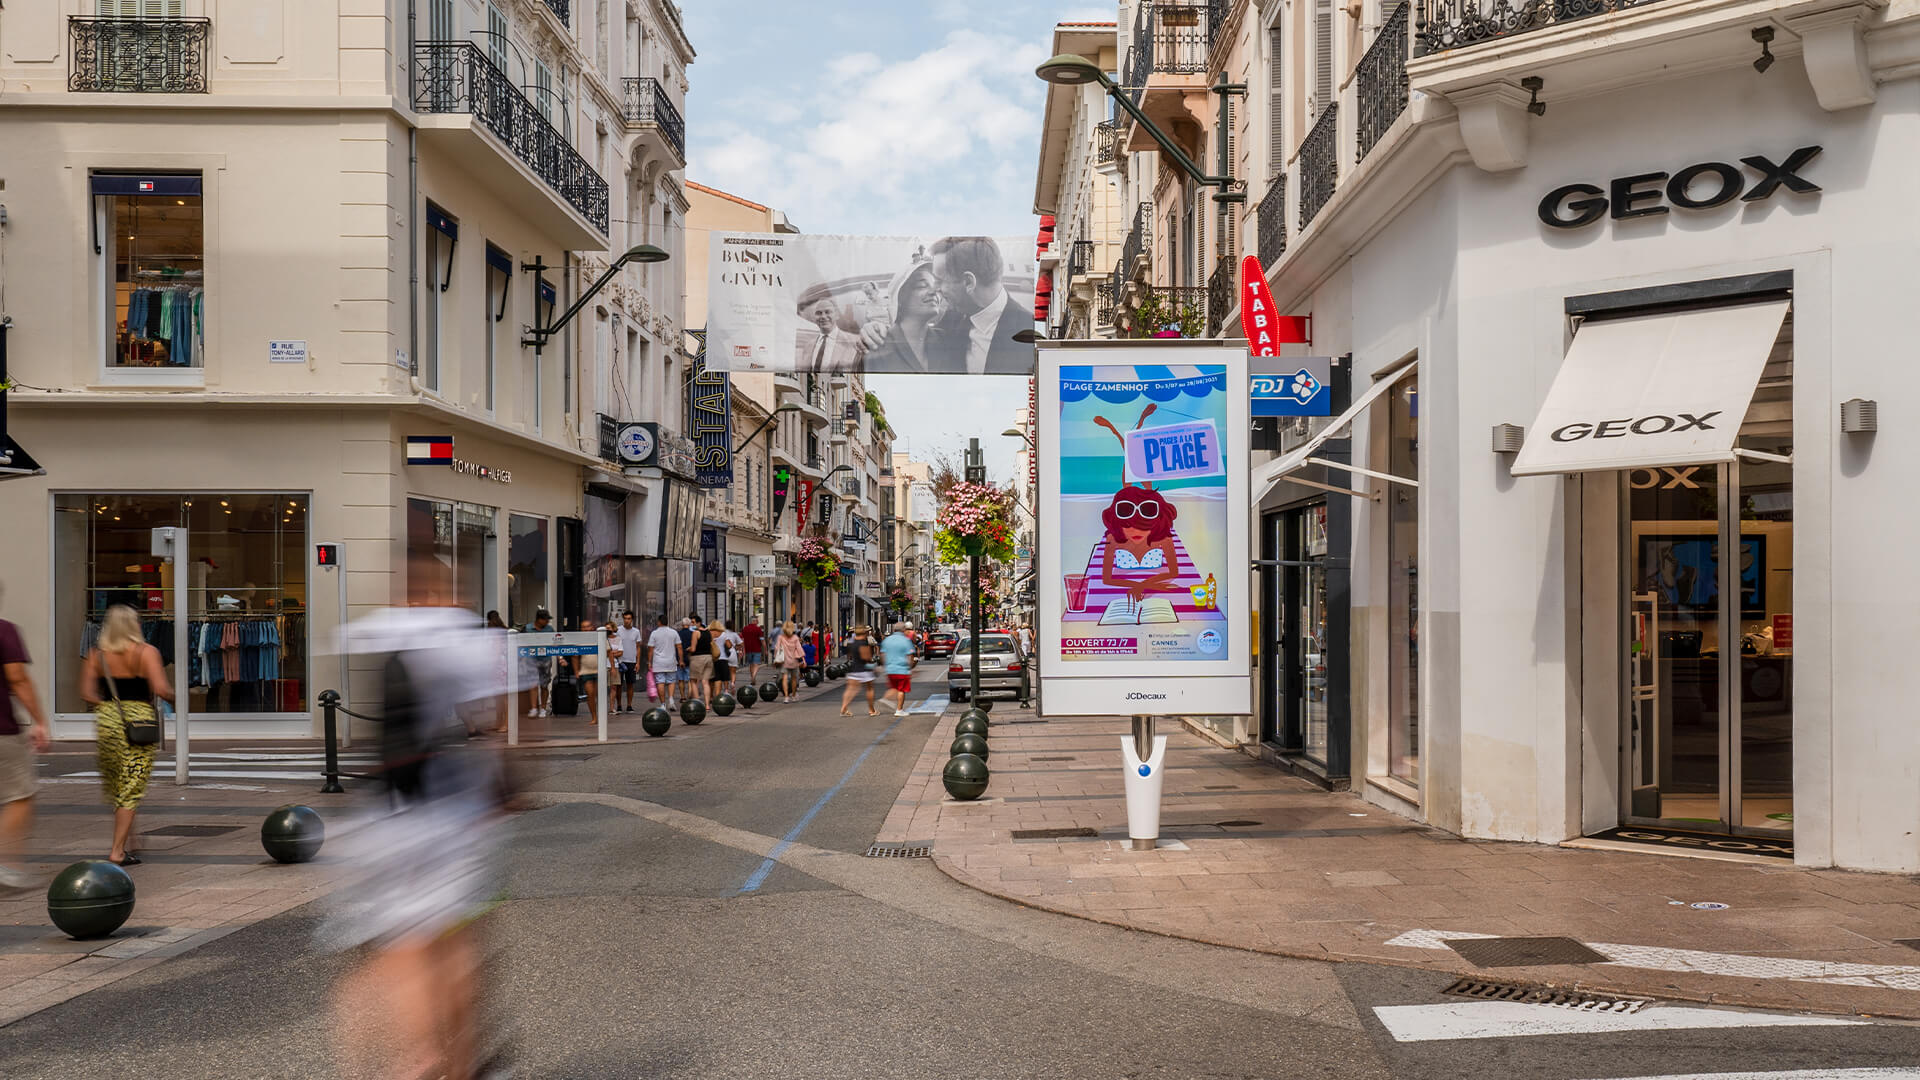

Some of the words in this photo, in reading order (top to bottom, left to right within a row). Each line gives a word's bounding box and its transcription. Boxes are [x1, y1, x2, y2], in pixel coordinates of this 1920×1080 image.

[1538, 145, 1823, 229] GEOX
[722, 248, 784, 264] BAISERS
[721, 272, 783, 288] CINEMA
[1248, 281, 1274, 357] TABAC
[1063, 382, 1093, 391] PLAGE
[1094, 383, 1149, 392] ZAMENHOF
[1250, 378, 1285, 394] FDJ
[1550, 410, 1723, 443] GEOX
[1143, 431, 1209, 474] PLAGE
[453, 458, 480, 476] TOMMY
[1065, 639, 1105, 647] OUVERT
[1125, 692, 1167, 701] JCDecaux
